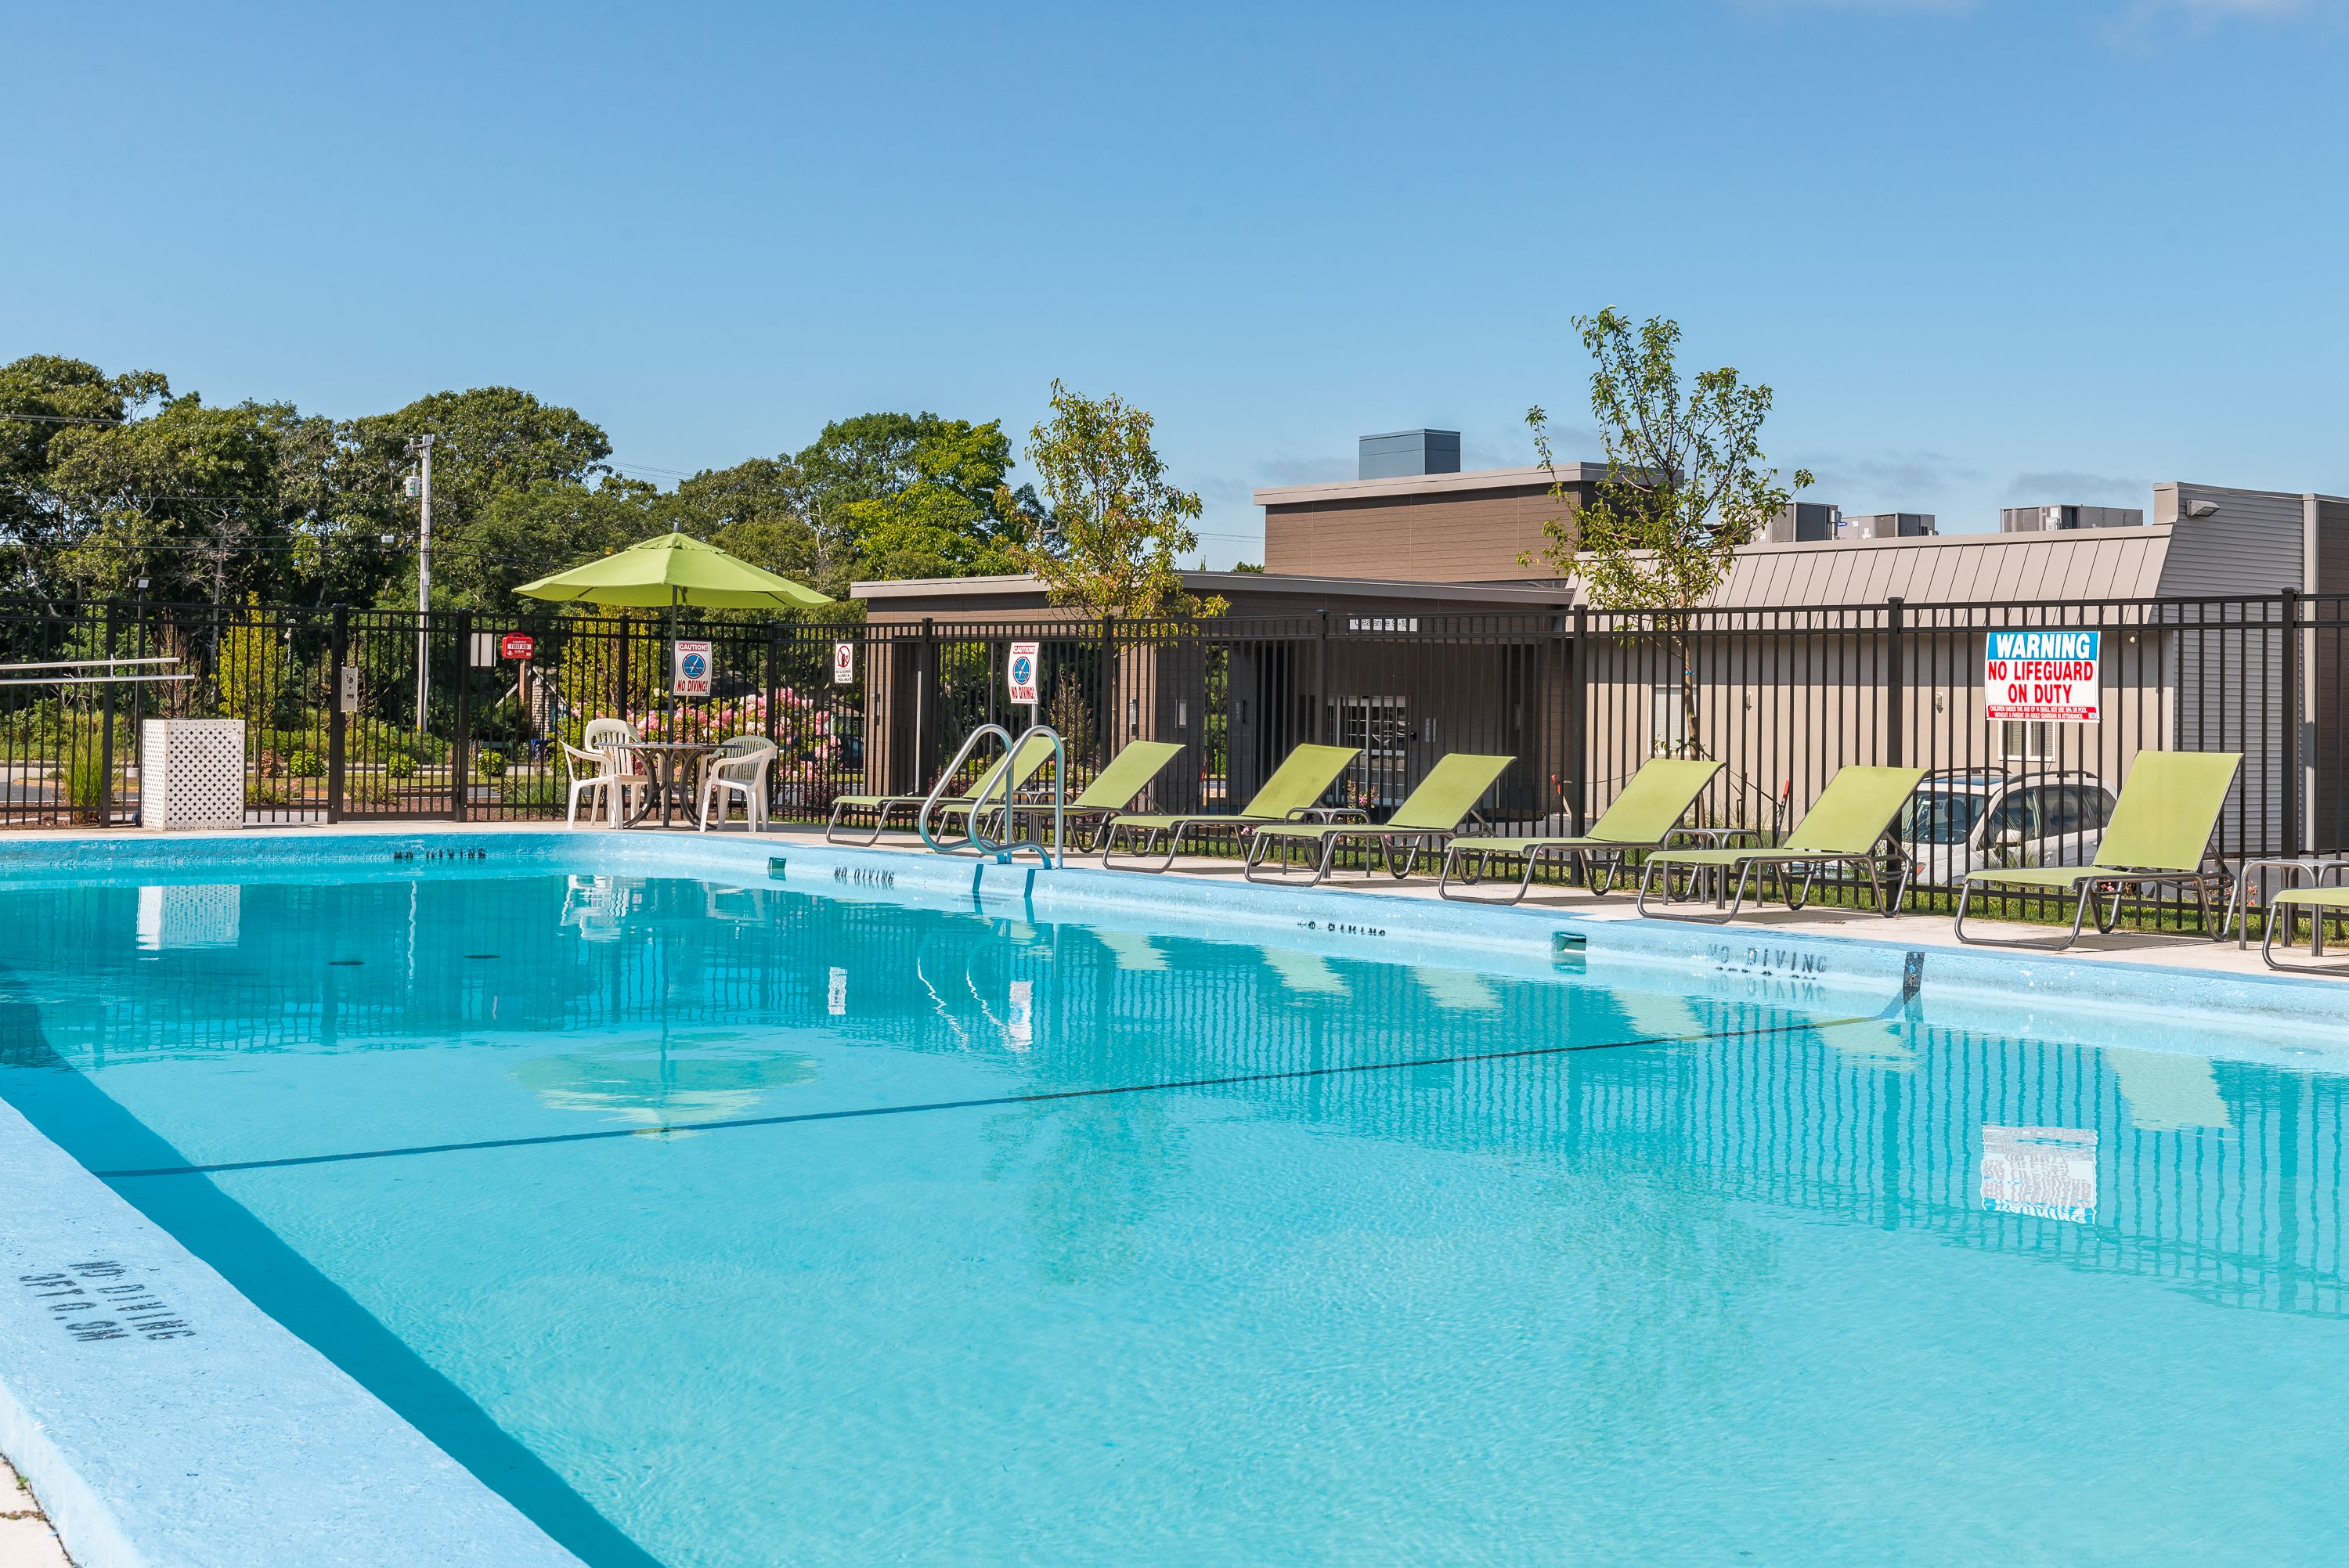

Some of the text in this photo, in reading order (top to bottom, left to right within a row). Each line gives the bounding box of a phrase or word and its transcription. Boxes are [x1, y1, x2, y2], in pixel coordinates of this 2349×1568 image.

[1996, 633, 2091, 659] WARNING
[1988, 661, 2094, 681] NO LIFEGUARD
[677, 680, 709, 692] NO DIVING!
[1011, 687, 1036, 700] NO DIVING!
[2008, 683, 2073, 704] ON DUTY
[1747, 947, 1828, 973] DIVING
[68, 1260, 197, 1341] NO DIVING
